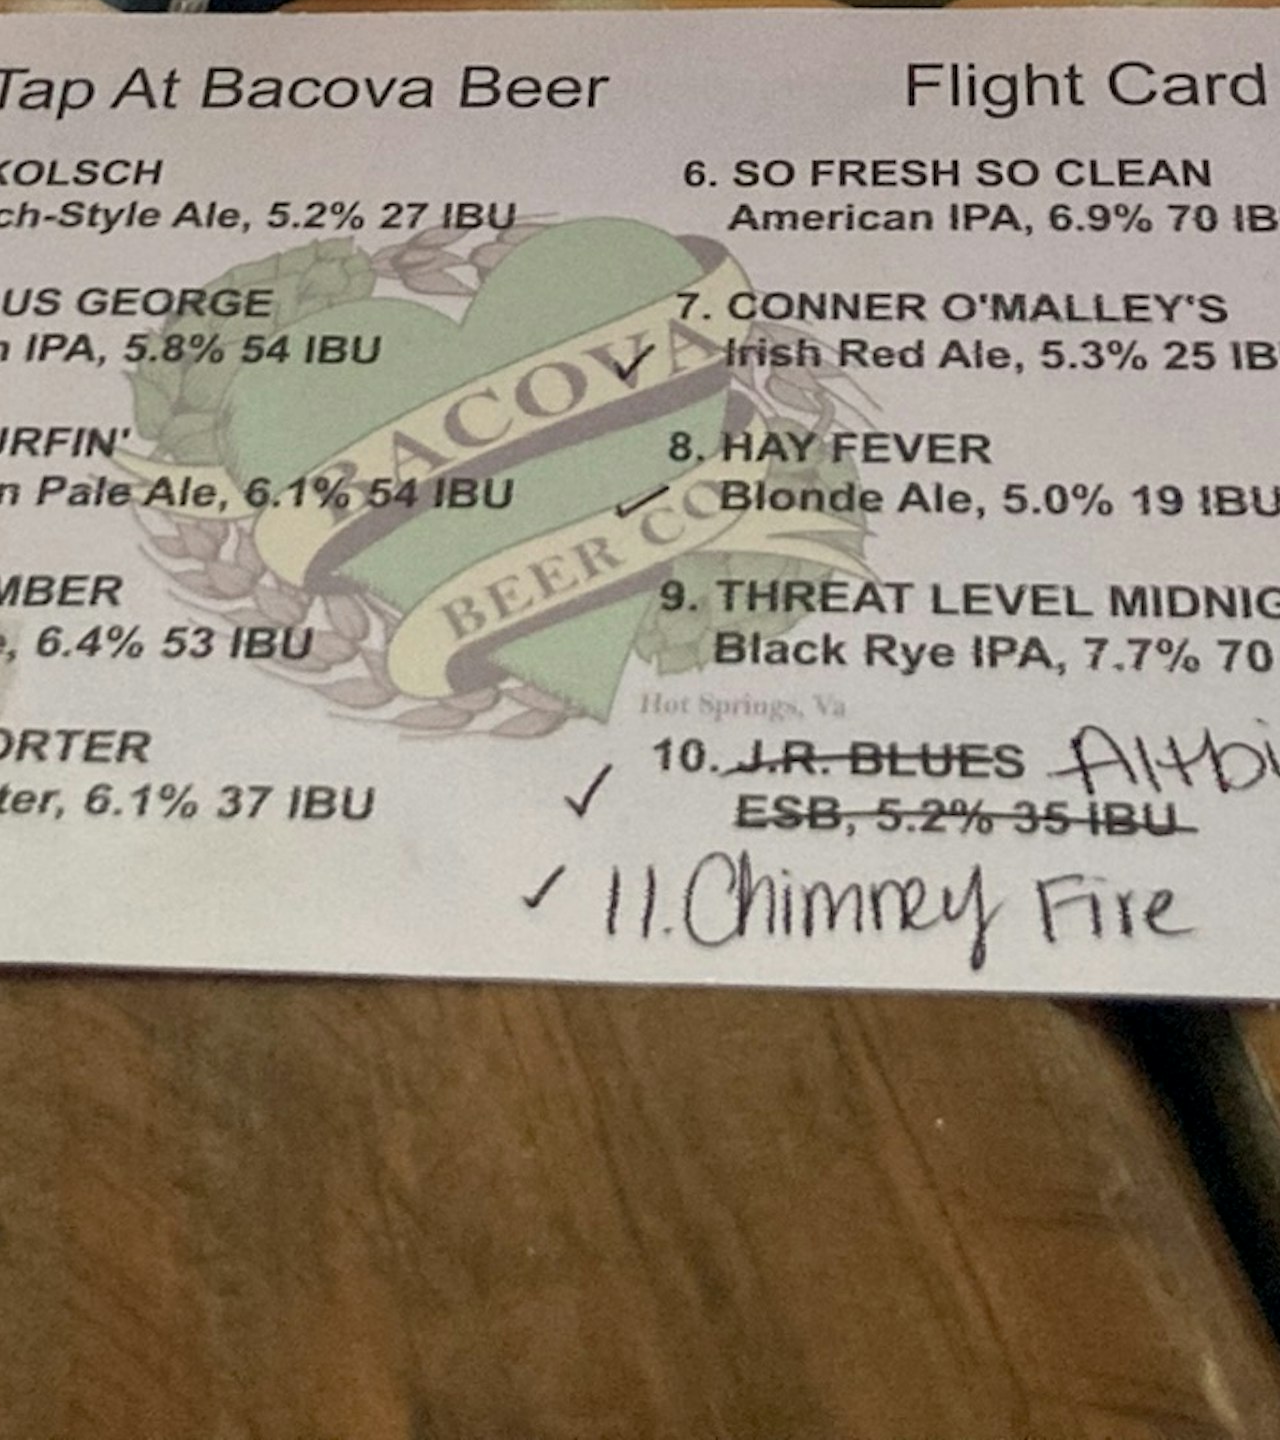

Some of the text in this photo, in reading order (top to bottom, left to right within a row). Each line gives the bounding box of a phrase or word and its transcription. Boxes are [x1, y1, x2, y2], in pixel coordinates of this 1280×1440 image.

[109, 67, 181, 109] At
[201, 66, 433, 109] Bacova
[459, 65, 610, 109] Beer
[907, 61, 1267, 119] Flight Card
[684, 158, 1211, 188] 6. SO FRESH SO CLEAN
[171, 201, 250, 233] Ale,
[267, 201, 365, 230] 5.2%
[379, 202, 429, 229] 27
[442, 202, 516, 231] IBU
[727, 203, 933, 231] American
[950, 203, 1033, 236] IPA,
[1049, 203, 1153, 233] 6.9%
[1167, 204, 1218, 233] 70
[77, 287, 274, 318] GEORGE
[676, 292, 1228, 324] 7. CONNER O'MALLEY'S
[26, 333, 106, 367] IPA,
[124, 333, 225, 364] 5.8%
[241, 334, 290, 364] 54
[304, 335, 382, 365] IBU
[725, 339, 822, 370] Irish
[839, 338, 924, 368] Red
[938, 339, 1024, 374] Ale,
[1041, 340, 1148, 370] 5.3%
[1164, 340, 1216, 371] 25
[321, 318, 721, 524] BACOVA
[668, 431, 991, 464] 8. HAY FEVER
[36, 475, 131, 507] Pale
[141, 476, 227, 512] Ale,
[244, 476, 350, 510] 6.1%
[366, 478, 419, 509] 54
[433, 477, 514, 510] IBU
[720, 480, 883, 513] Blonde
[897, 482, 985, 519] Ale,
[1004, 483, 1113, 516] 5.0%
[1132, 485, 1184, 516] 19
[439, 538, 623, 641] BEER
[660, 579, 698, 612] 9.
[716, 579, 914, 614] THREAT
[932, 583, 1093, 617] LEVEL
[37, 626, 144, 658] 6.4%
[163, 627, 214, 658] 53
[230, 626, 313, 660] IBU
[714, 631, 846, 665] Black
[865, 634, 955, 676] Rye
[973, 636, 1066, 676] IPA,
[1084, 637, 1200, 673] 7.7%
[1217, 640, 1273, 673] 70
[639, 692, 845, 723] Hot Springs, Va
[654, 738, 1025, 778] 10. J.R. BLUES
[85, 784, 197, 818] 6.1%
[218, 786, 272, 818] 37
[289, 787, 374, 820] IBU
[734, 795, 1180, 836] ESB, 5.2% 35 IBU
[1038, 874, 1195, 943] Fire
